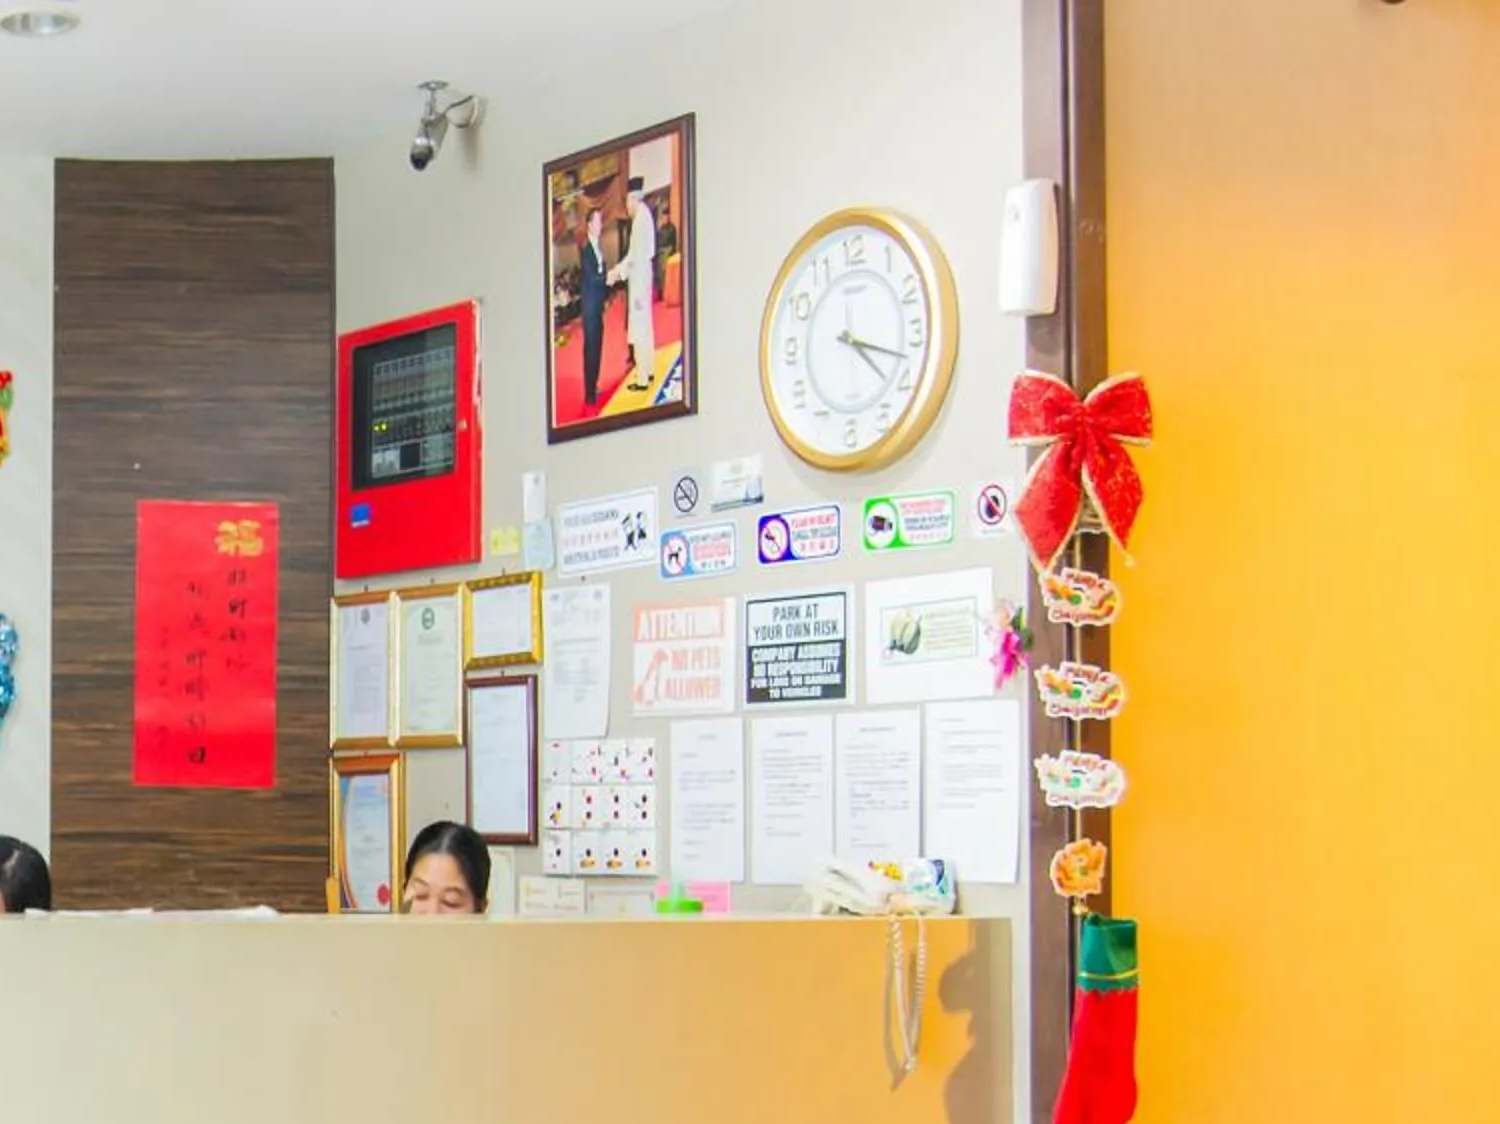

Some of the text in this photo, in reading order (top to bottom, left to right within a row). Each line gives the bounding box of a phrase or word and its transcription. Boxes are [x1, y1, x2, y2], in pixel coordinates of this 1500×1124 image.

[843, 234, 867, 266] 12
[884, 245, 892, 273] 1
[812, 257, 830, 288] 11
[902, 273, 917, 304] 2
[789, 292, 811, 322] 10
[910, 318, 922, 348] 3
[785, 336, 798, 366] 9
[897, 368, 912, 393] 4
[875, 402, 891, 432] 5
[844, 419, 857, 448] 6
[639, 608, 721, 641] ATTENT
[772, 603, 819, 622] PARK AT
[753, 619, 838, 641] YOUR OWN RISK
